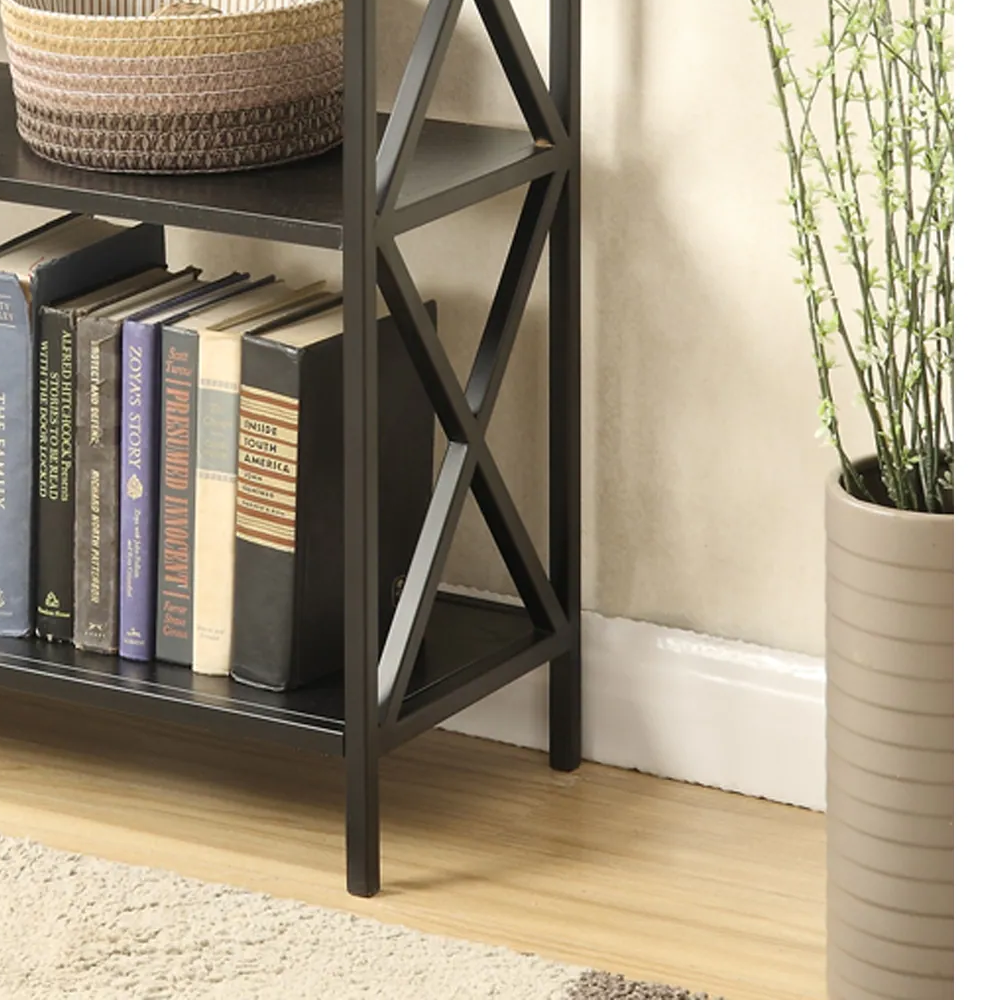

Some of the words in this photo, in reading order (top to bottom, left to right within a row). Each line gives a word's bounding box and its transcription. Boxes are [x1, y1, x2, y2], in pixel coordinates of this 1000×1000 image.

[39, 340, 49, 376] WITH
[61, 330, 72, 380] ALFRED
[127, 345, 143, 407] ZOYA'S
[39, 378, 49, 404] THE
[50, 371, 60, 425] STORIES
[39, 406, 49, 444] DOOR
[49, 427, 60, 446] TO
[61, 382, 73, 458] HITCHCOCK
[127, 412, 142, 471] STORY
[165, 387, 191, 491] PRESUMED
[243, 419, 278, 437] INSIDE
[39, 445, 48, 498] LOCKED
[49, 464, 60, 500] READ
[243, 453, 291, 474] AMERICA
[164, 495, 190, 589] INNOCENT
